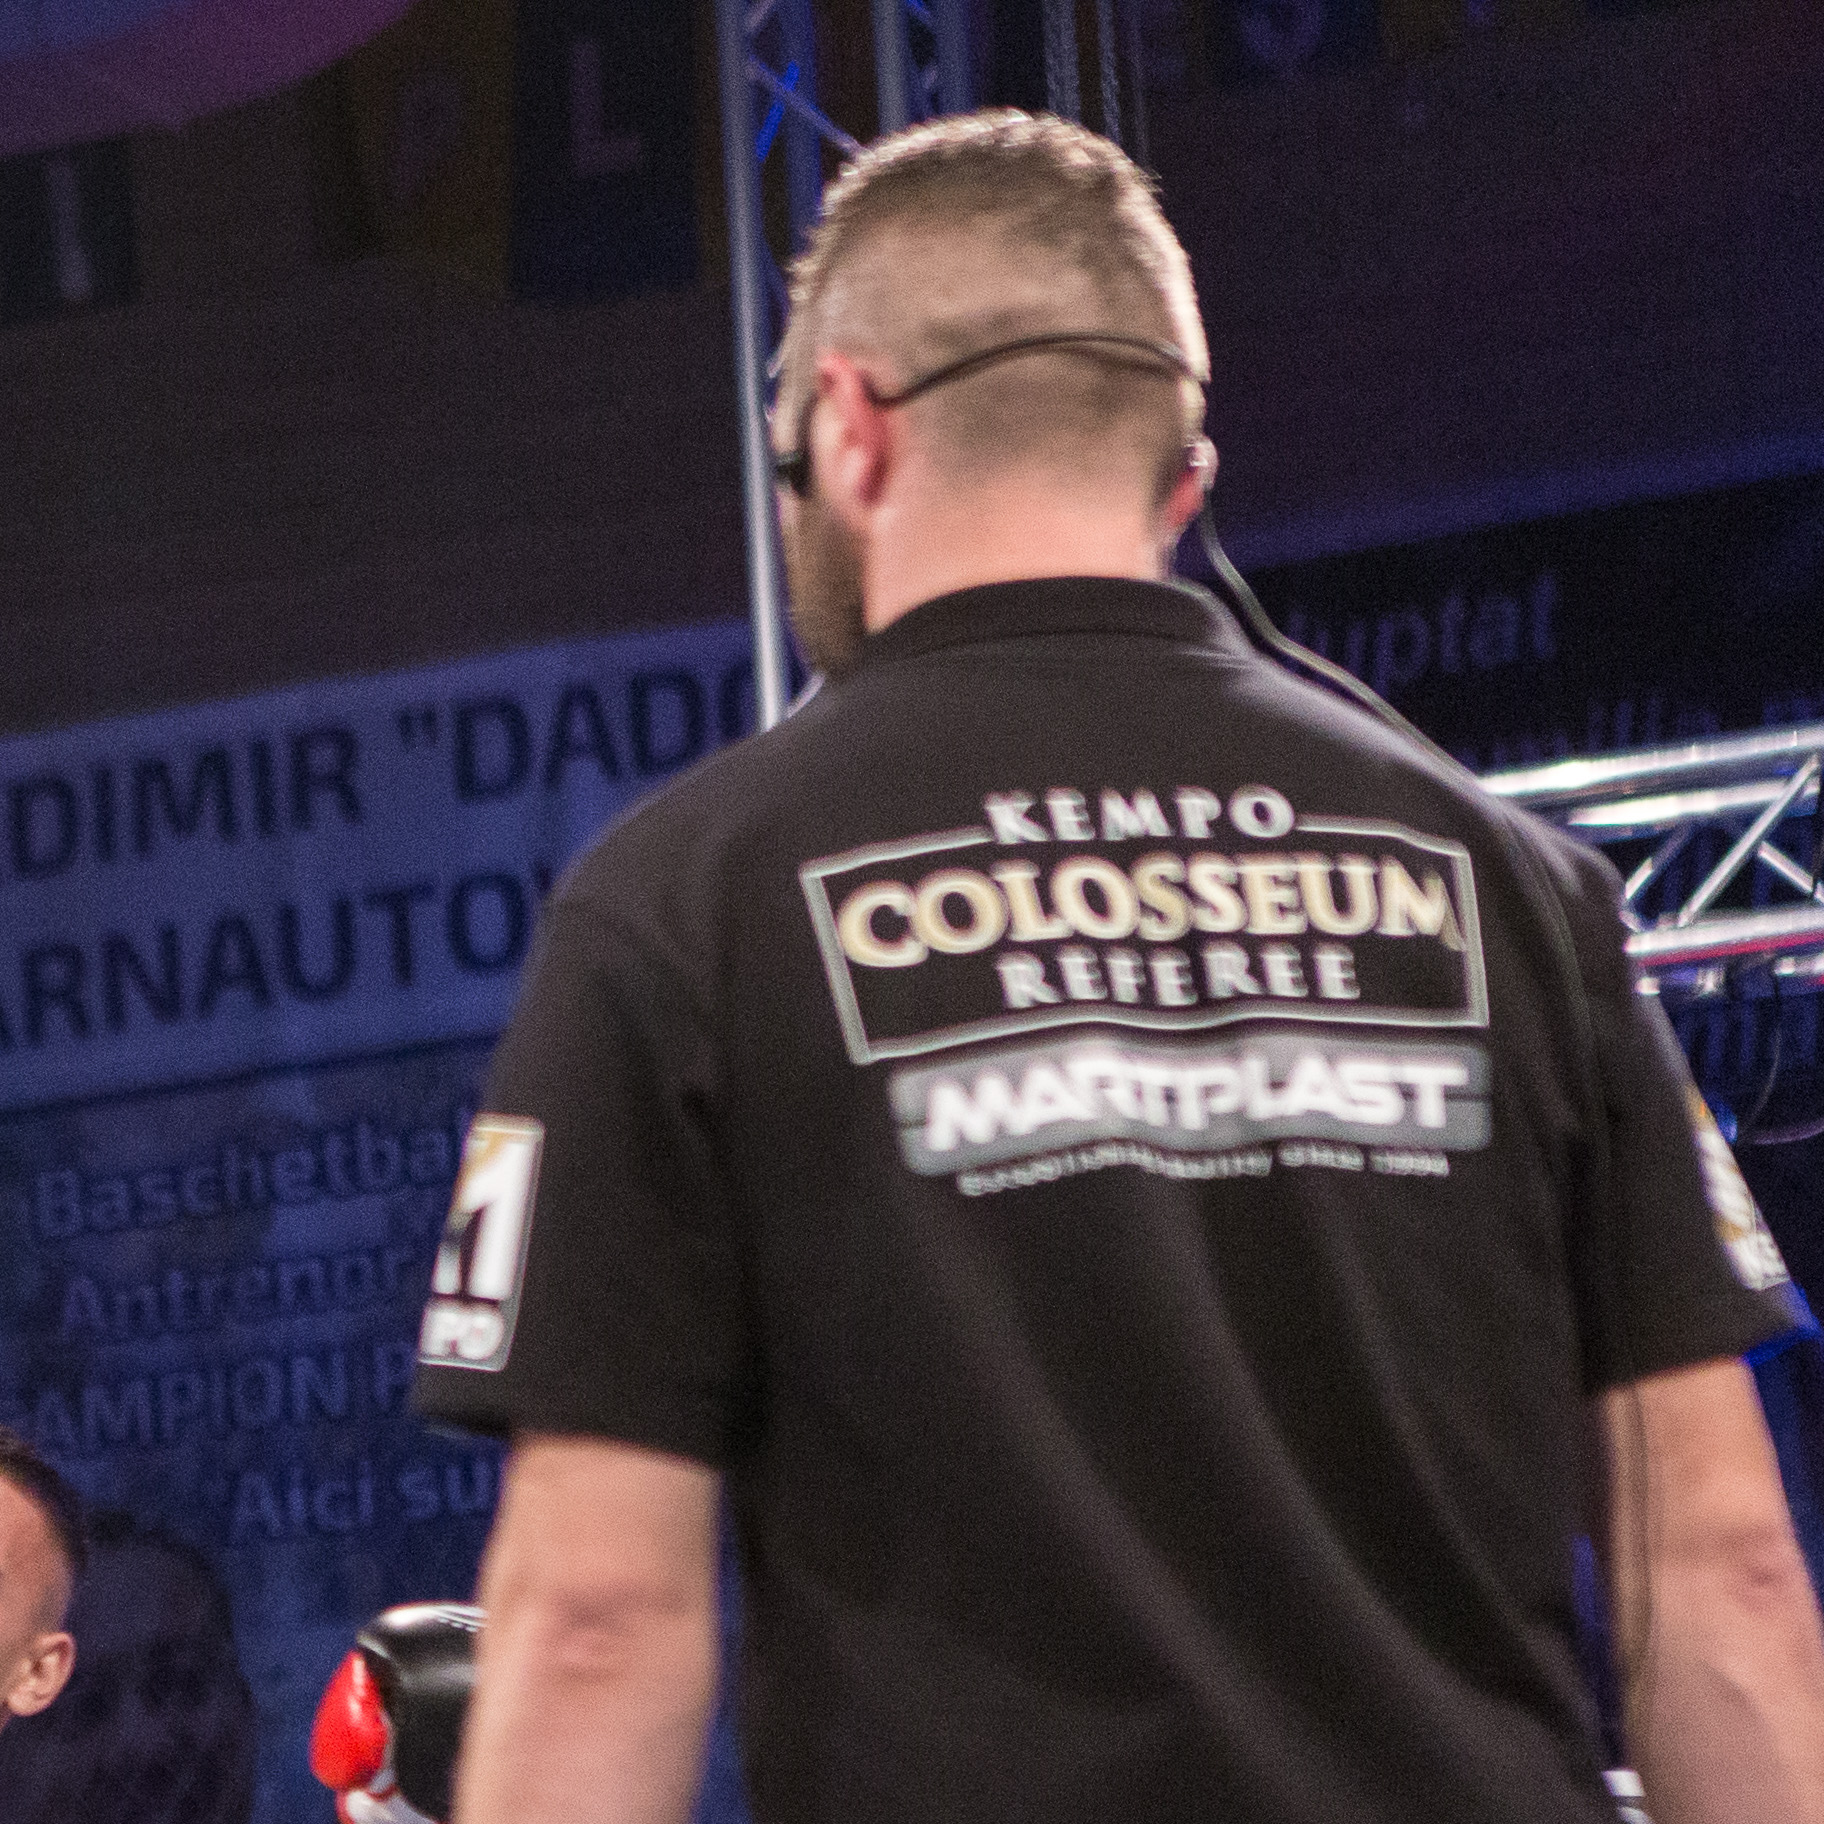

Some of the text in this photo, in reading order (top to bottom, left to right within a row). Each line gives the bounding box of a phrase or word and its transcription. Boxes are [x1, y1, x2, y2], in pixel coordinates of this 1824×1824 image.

[986, 785, 1296, 844] KEMPO
[998, 941, 1360, 1009] REFEREE
[925, 1050, 1468, 1152] MARTPLAST
[33, 1109, 468, 1240] Baschetba
[37, 1350, 348, 1454] AMPION
